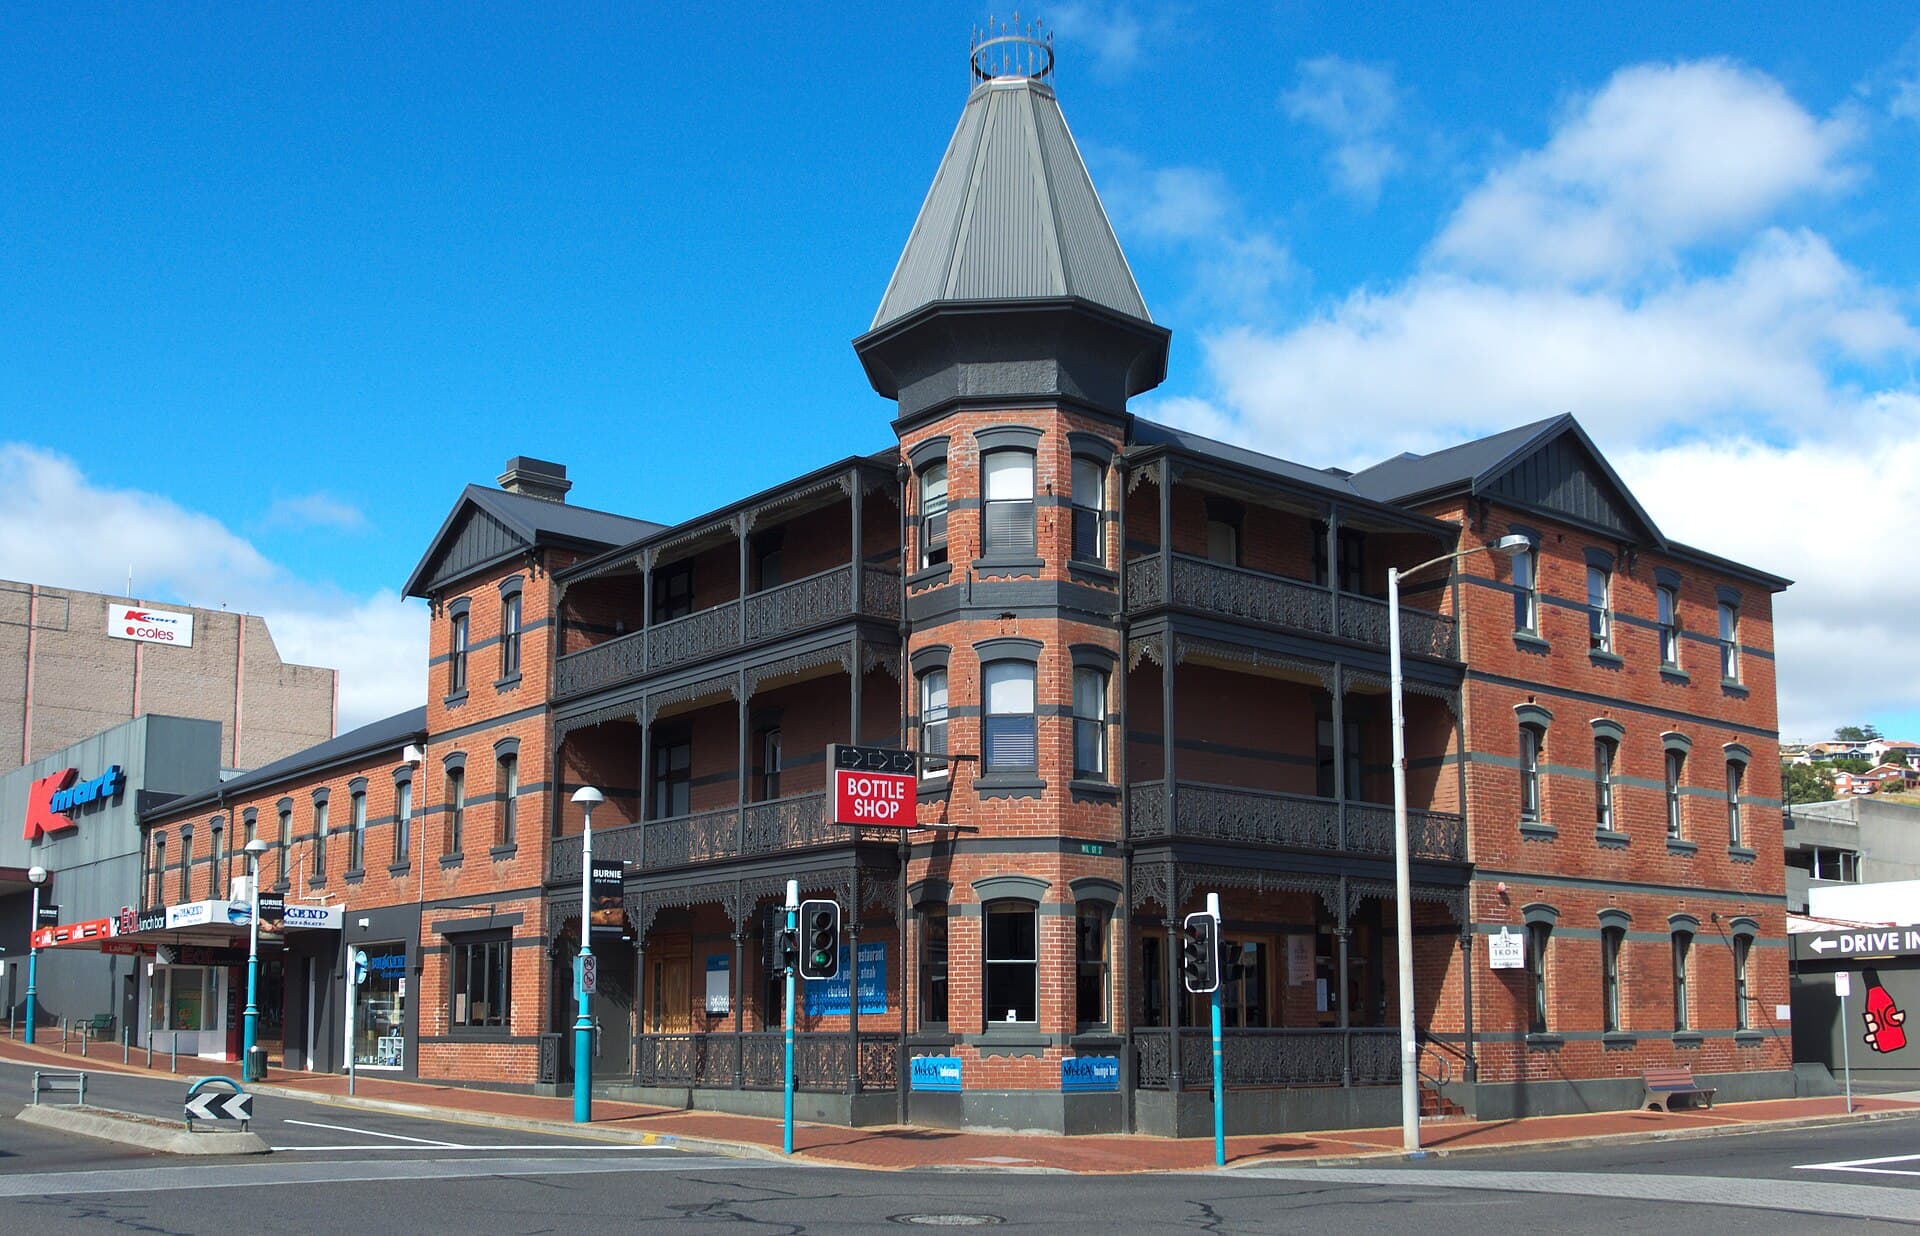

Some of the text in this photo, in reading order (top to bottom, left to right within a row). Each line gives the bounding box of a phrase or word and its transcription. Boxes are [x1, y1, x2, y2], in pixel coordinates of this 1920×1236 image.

[124, 610, 178, 623] Kmart
[137, 628, 174, 641] coles
[847, 777, 905, 800] BOTTLE
[23, 764, 121, 841] Kmart
[854, 798, 899, 819] SHOP
[593, 869, 622, 878] BURNIE
[1840, 932, 1899, 952] DRIVE
[858, 947, 884, 962] estaurant
